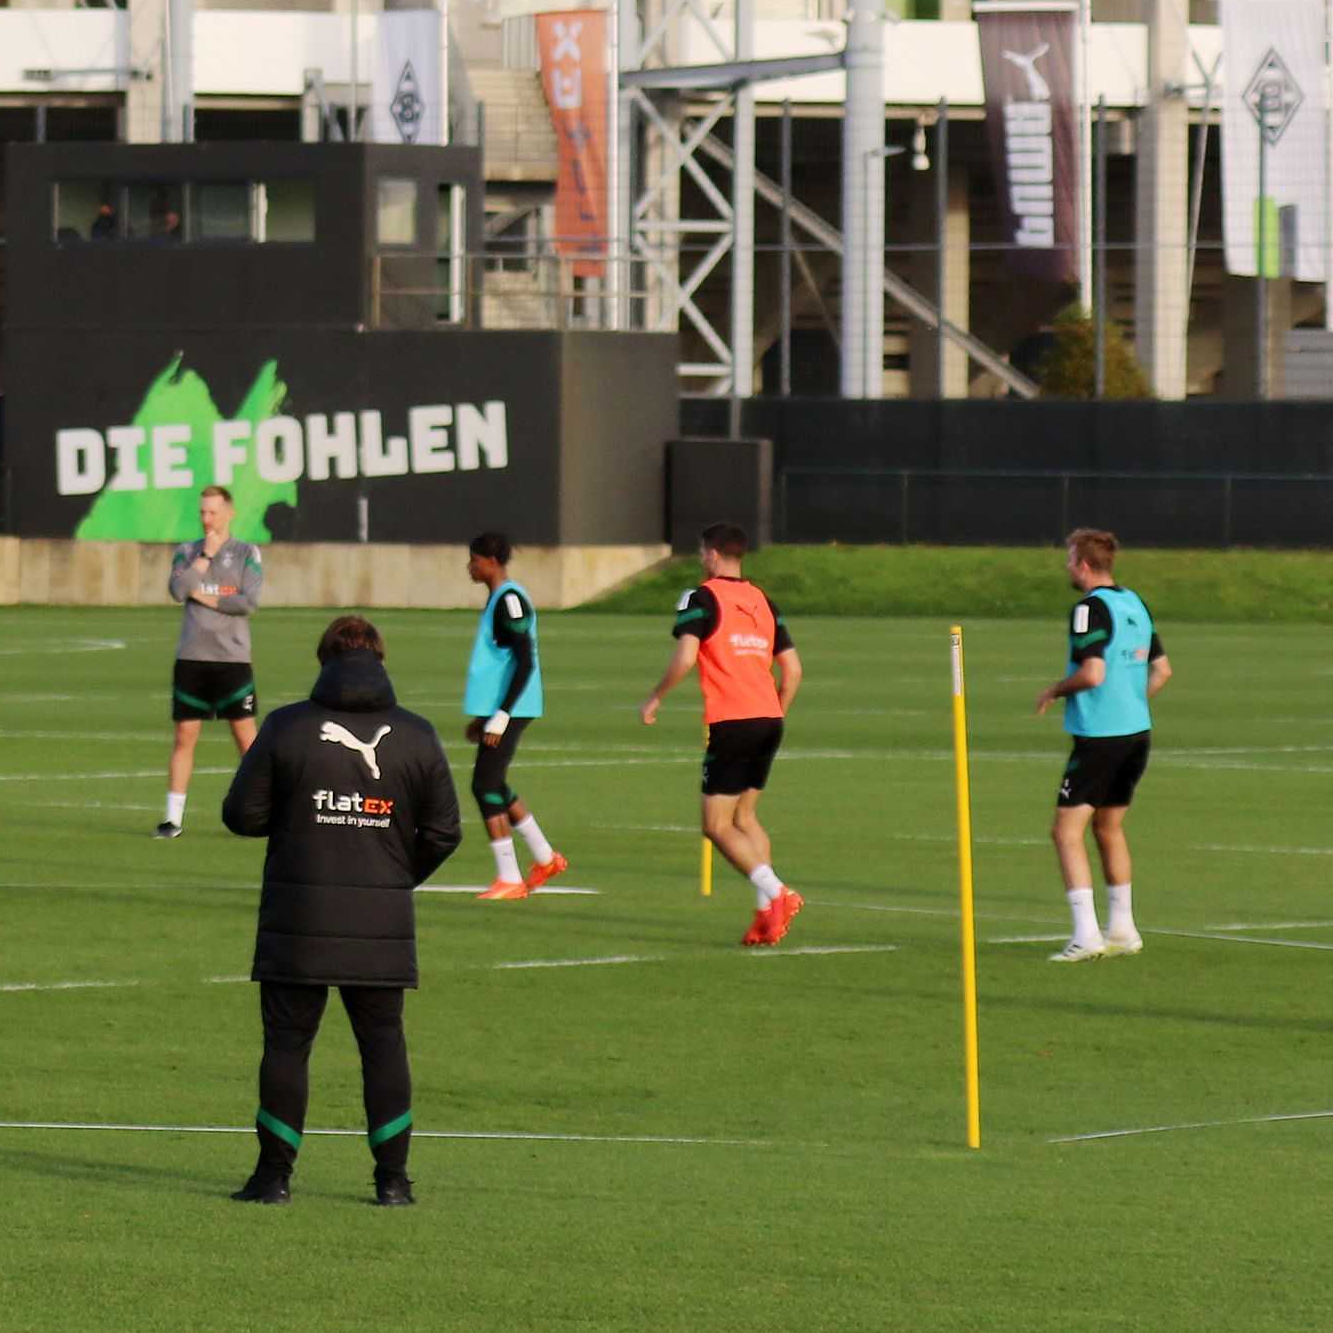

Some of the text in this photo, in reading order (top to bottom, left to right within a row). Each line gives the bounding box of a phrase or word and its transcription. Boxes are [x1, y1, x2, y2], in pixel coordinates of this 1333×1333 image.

[1004, 99, 1055, 248] PUMA
[55, 401, 508, 495] DIE FOHLEN
[312, 789, 394, 814] flatEX
[317, 813, 390, 828] Invest in yourself
